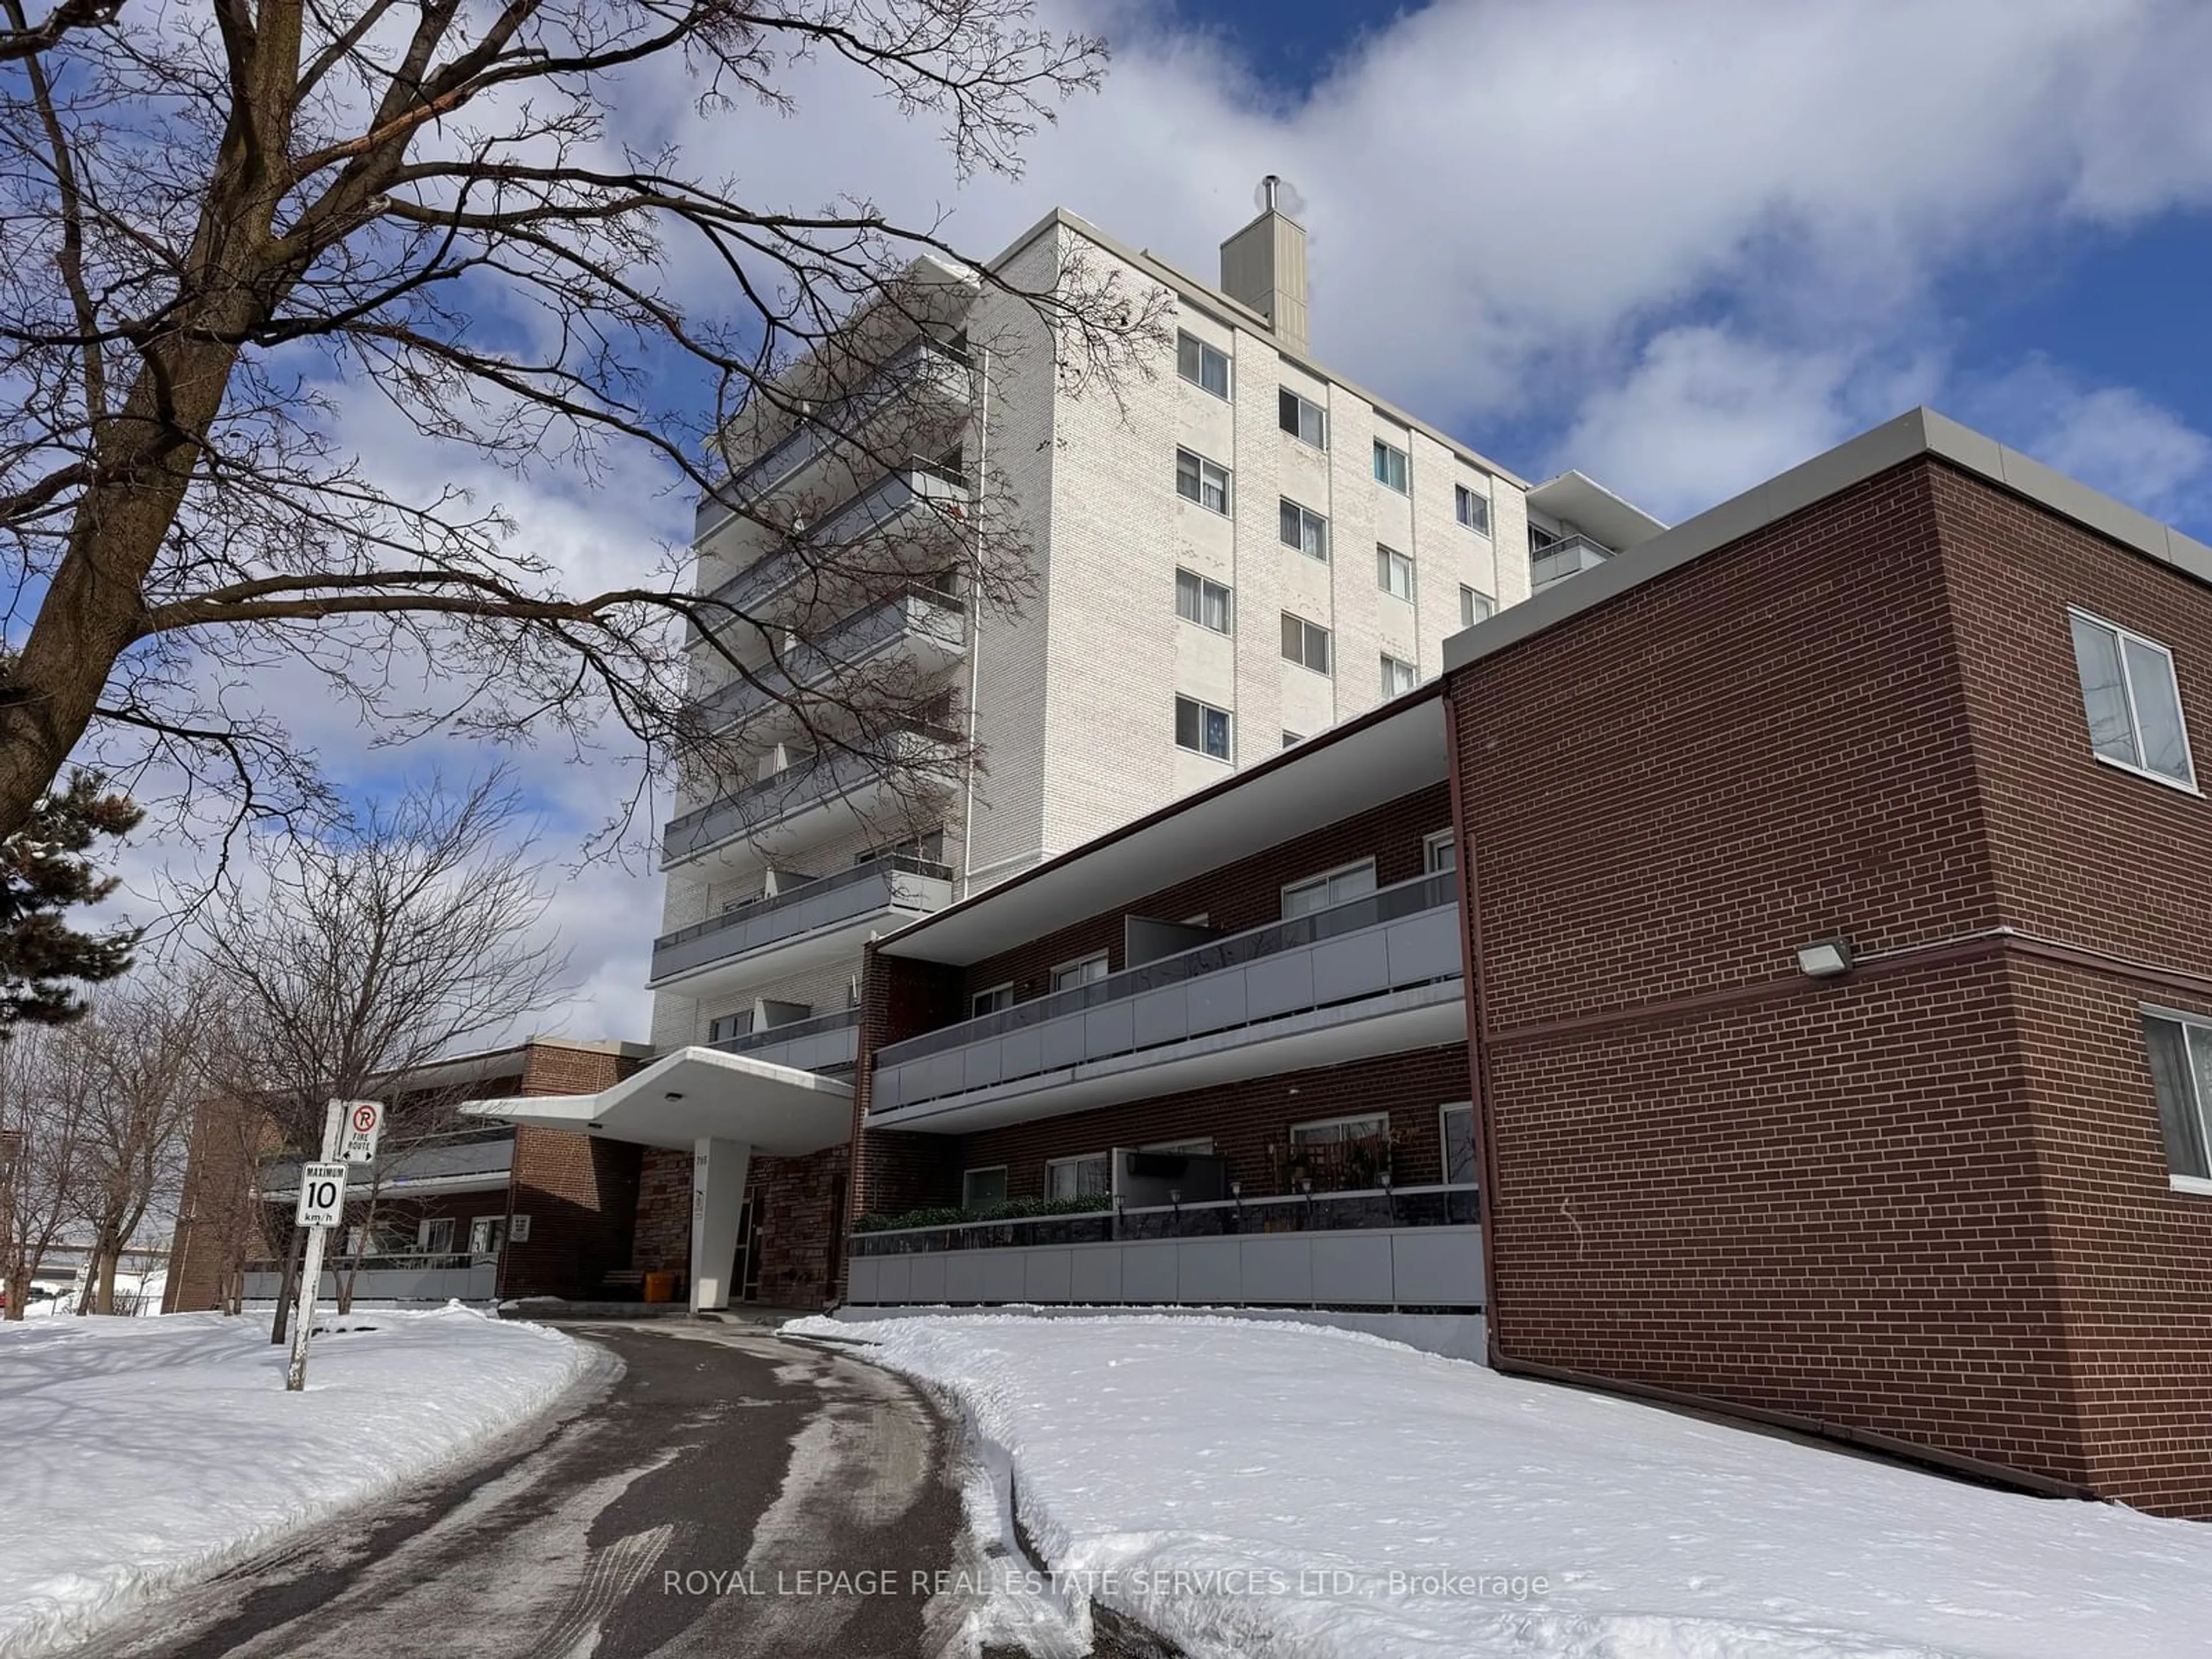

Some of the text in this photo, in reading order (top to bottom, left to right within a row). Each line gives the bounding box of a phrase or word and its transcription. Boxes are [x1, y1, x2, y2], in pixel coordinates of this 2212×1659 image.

[353, 1133, 369, 1141] FIRE
[348, 1141, 370, 1150] ROUTE
[306, 1167, 344, 1177] MAXIMUM
[308, 1181, 336, 1209] 10
[304, 1214, 333, 1222] km/h
